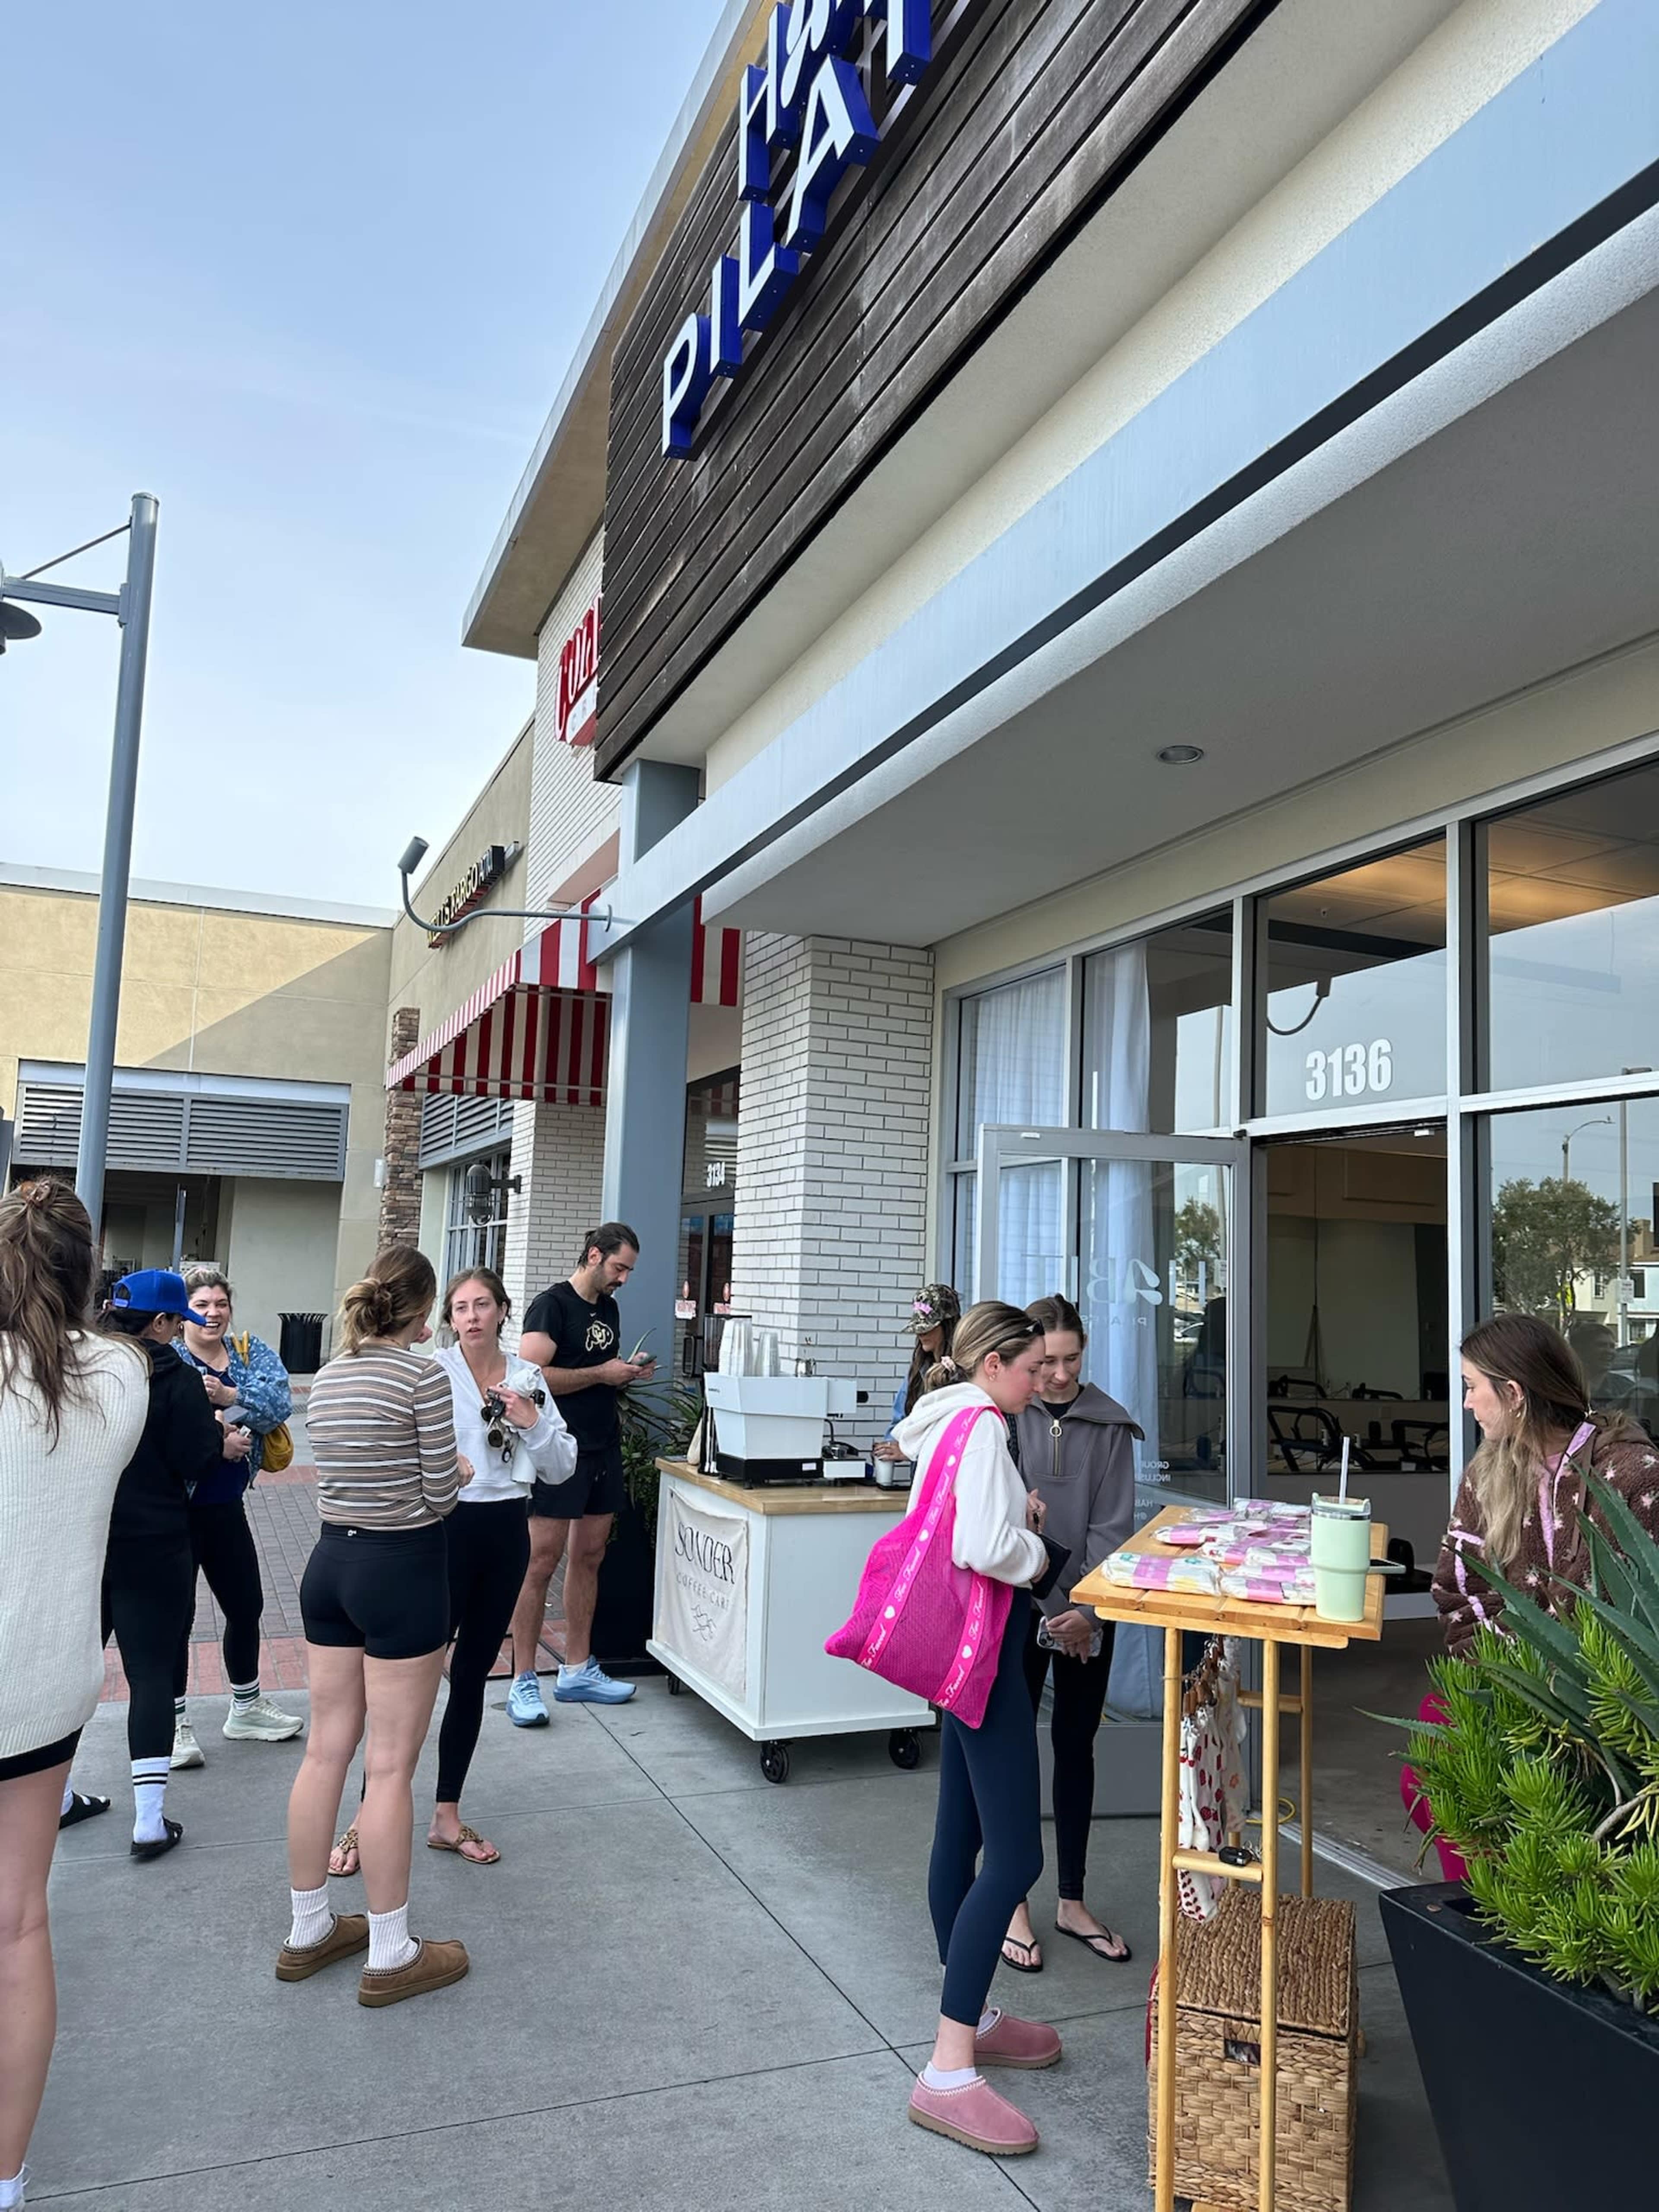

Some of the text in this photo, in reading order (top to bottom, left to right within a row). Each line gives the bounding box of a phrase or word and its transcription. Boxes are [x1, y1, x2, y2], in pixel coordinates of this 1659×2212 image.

[1305, 1038, 1393, 1101] 3136
[707, 1161, 725, 1188] 3134
[675, 1521, 735, 1584] SONDER
[677, 1573, 730, 1611] COFFEE CART
